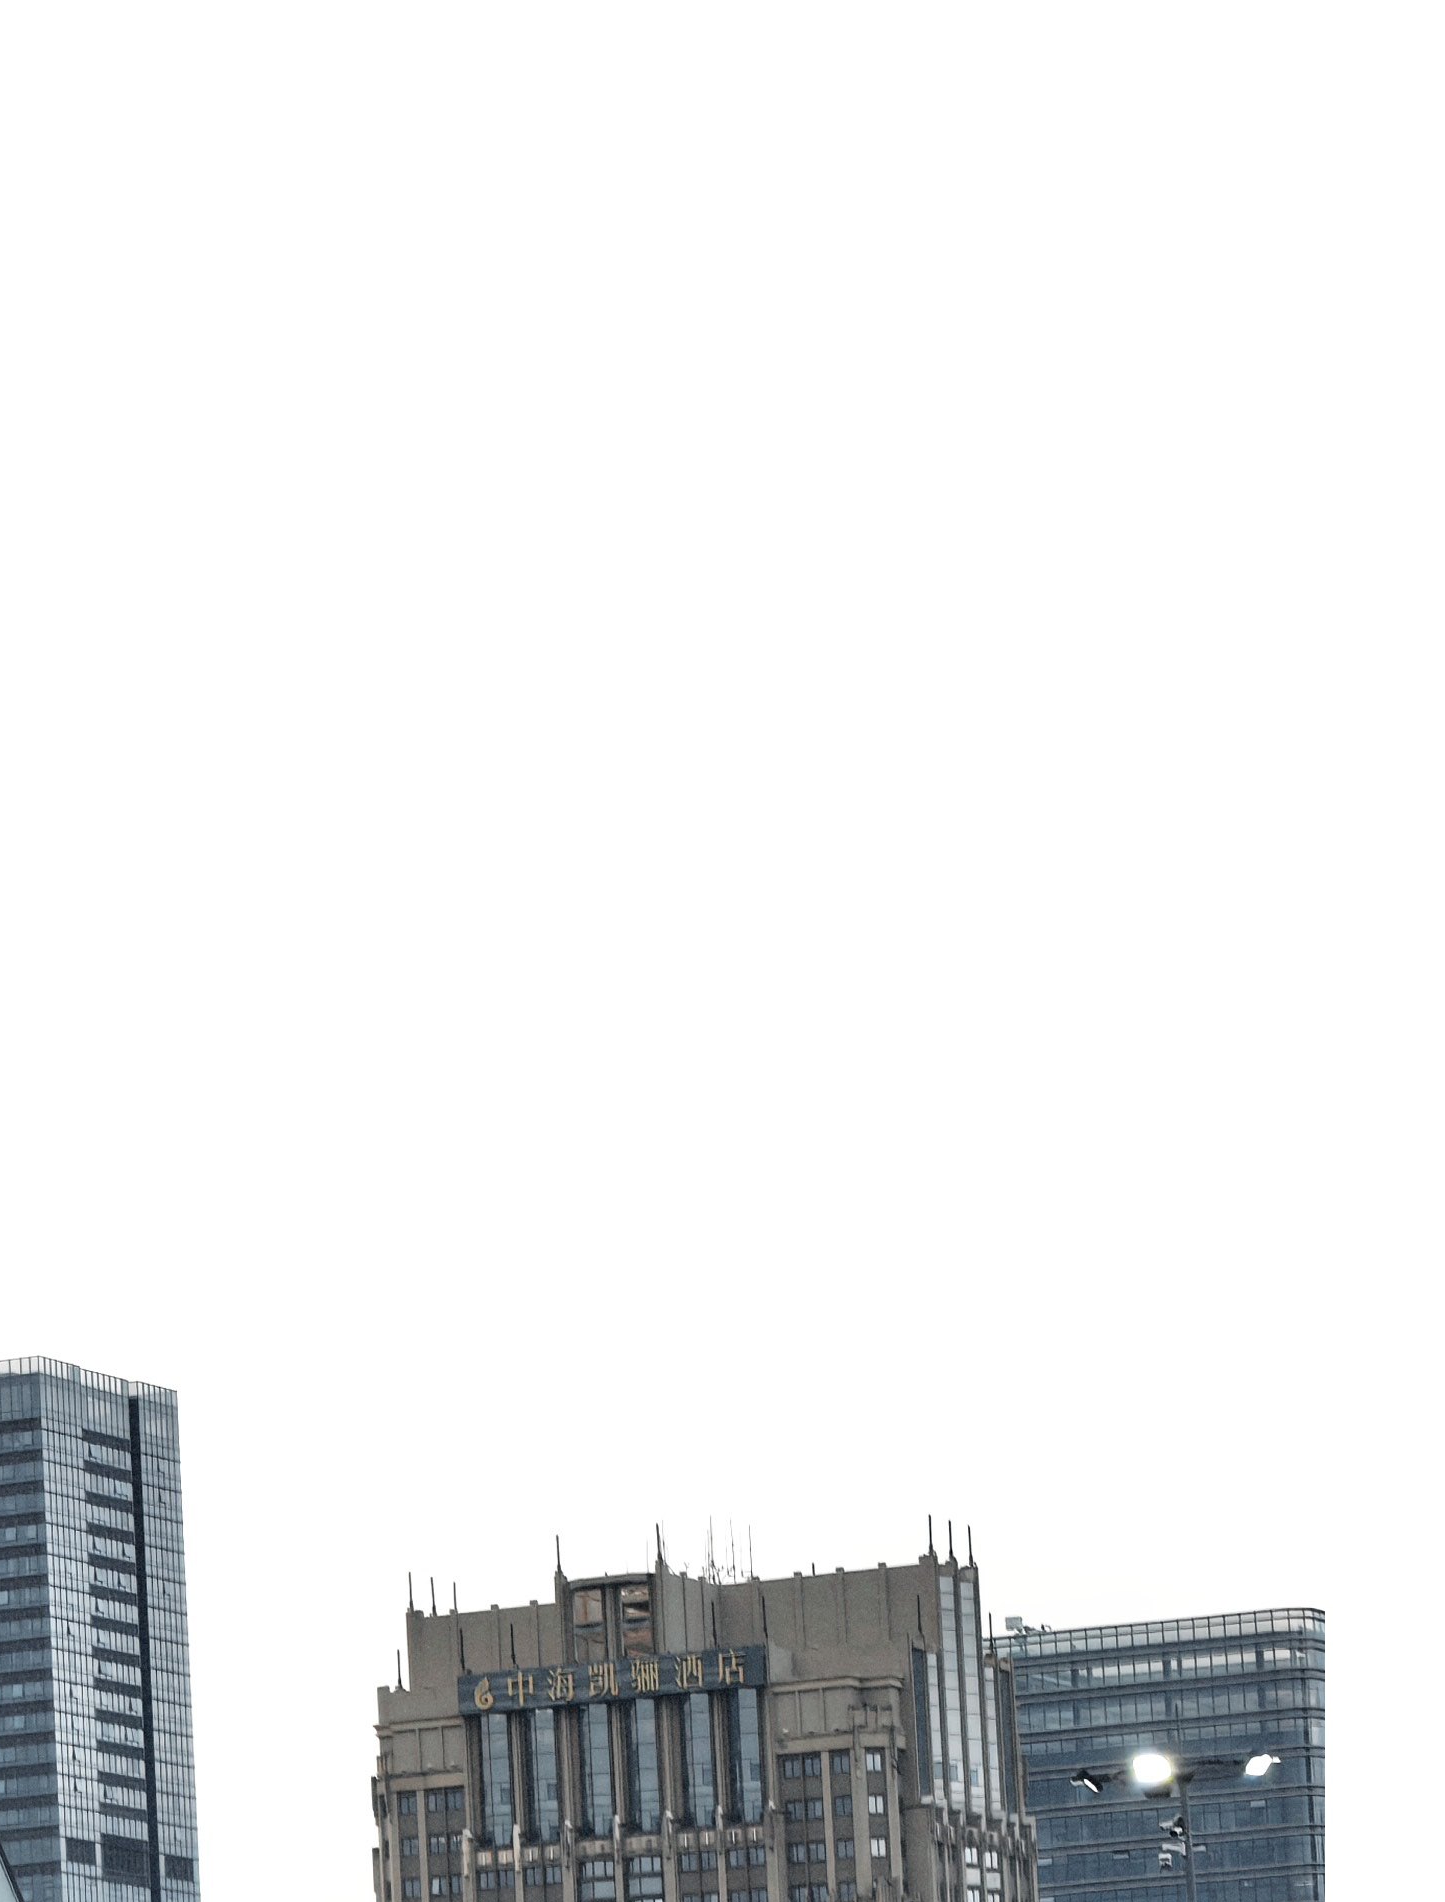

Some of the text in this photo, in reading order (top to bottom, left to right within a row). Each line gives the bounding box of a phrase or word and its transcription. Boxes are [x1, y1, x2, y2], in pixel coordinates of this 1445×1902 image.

[507, 1650, 745, 1707] 中海凯骊酒店
